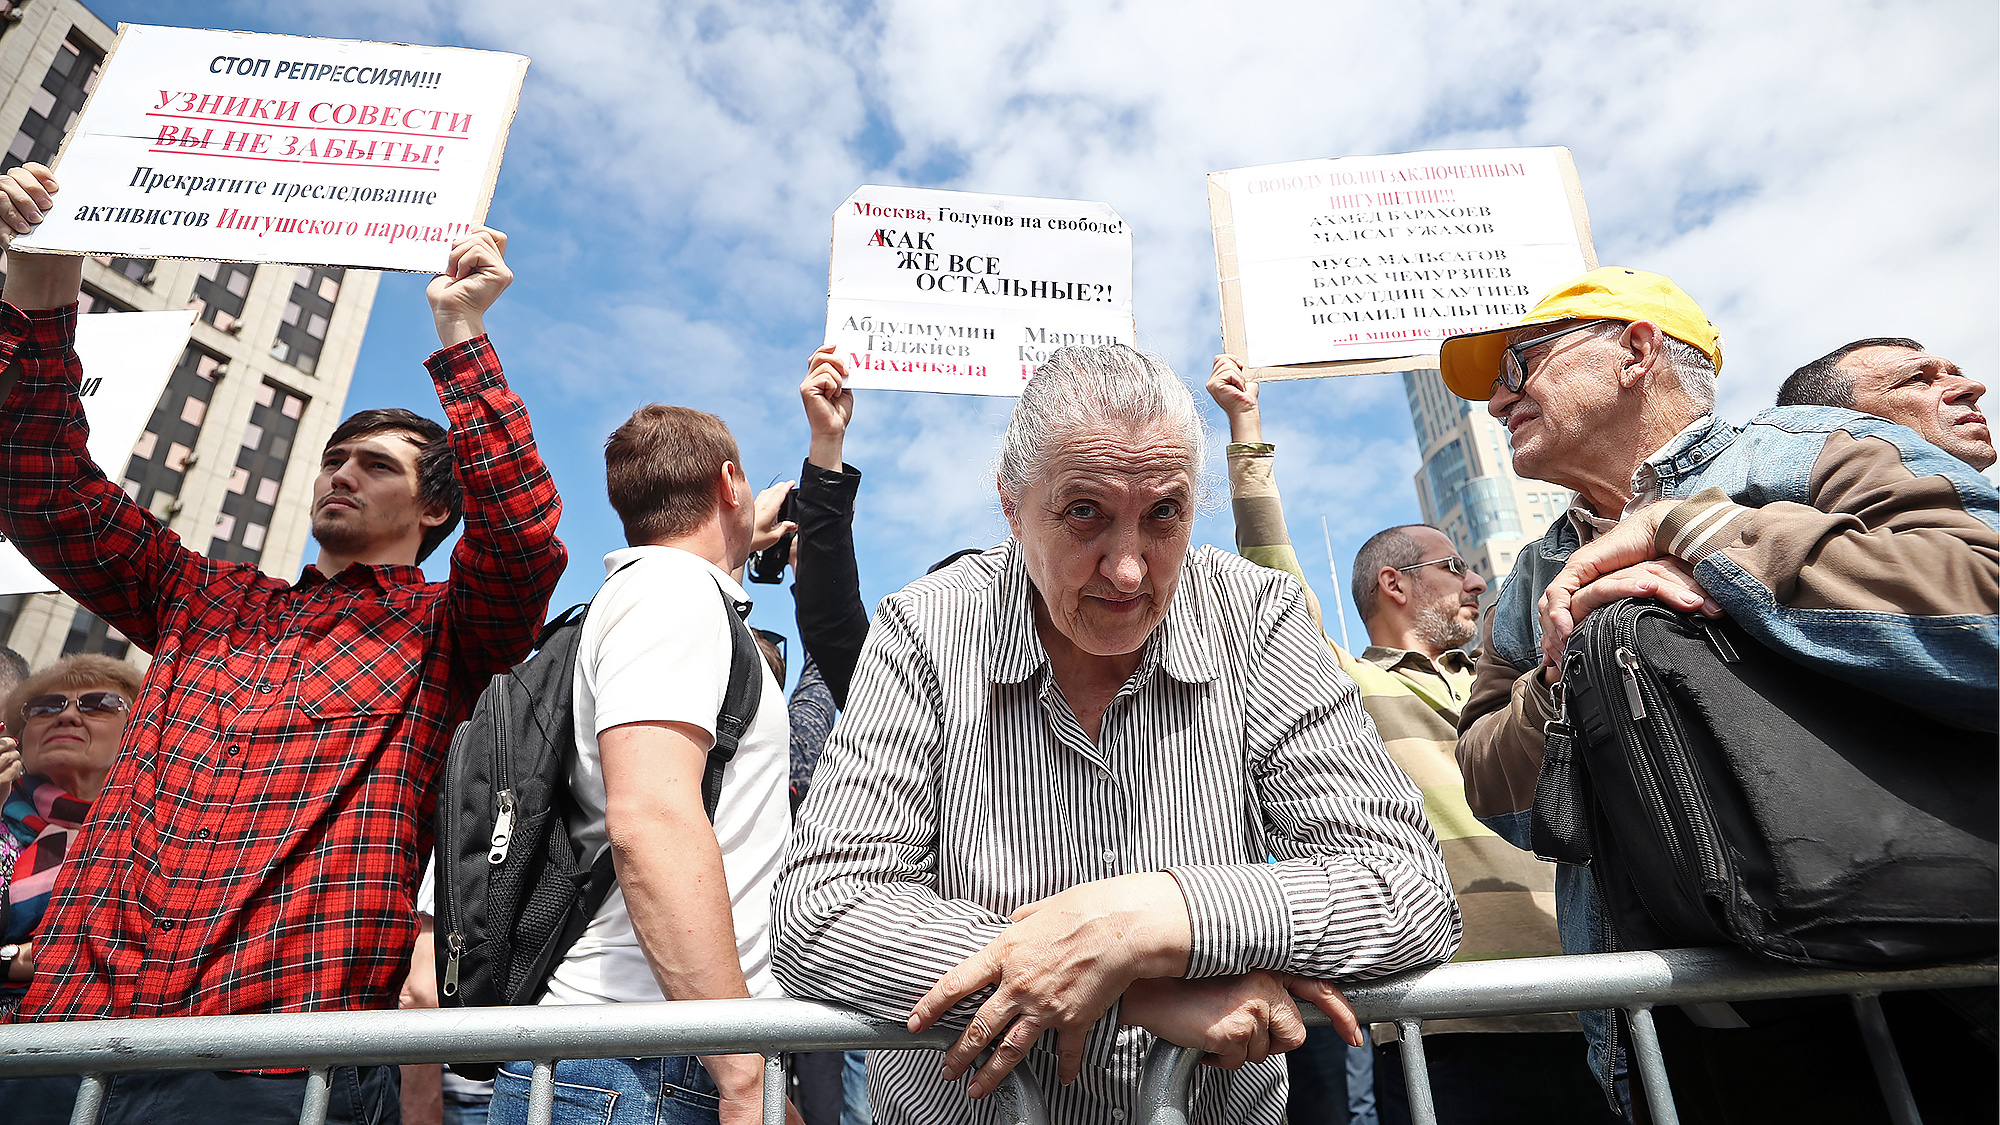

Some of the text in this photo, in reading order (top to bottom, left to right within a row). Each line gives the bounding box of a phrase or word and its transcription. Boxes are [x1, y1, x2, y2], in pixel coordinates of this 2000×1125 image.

[209, 55, 442, 90] СТОП РЕПРЕССИЯМ!!!
[154, 90, 473, 133] УЗНИКИ СОВЕСТИ
[154, 124, 445, 165] ВЫ НЕ ЗАБЫТЫ!
[128, 166, 437, 206] Прекратите преследование
[1247, 172, 1324, 195] СВОБОДУ
[1329, 188, 1456, 210] ИНГУШЕТИИ!!!
[74, 205, 210, 228] активистов
[216, 208, 359, 238] Ингушского
[853, 202, 1123, 235] Москва, Голунов на свободе!
[1310, 206, 1492, 228] АХМЕД БАРАХОЕВ
[1312, 223, 1494, 243] МАЛСАГ УЖАХОВ
[897, 251, 1001, 276] ЖЕ ВСЕ
[1311, 249, 1507, 270] МУСА МАЛЬСАГОВ
[916, 273, 1112, 303] ОСТАЛЬНЫЕ?!
[1313, 267, 1512, 289] БАРАХ ЧЕМУРЗИЕВ
[1302, 284, 1530, 307] БАГАУТДИН ХАУТИЕВ
[1311, 303, 1527, 325] ИСМАИЛ НАЛЬГИЕВ
[842, 315, 996, 341] Абдулмумин
[1366, 328, 1431, 340] многие
[867, 334, 970, 358] Гаджиев
[848, 352, 988, 378] Махачкала
